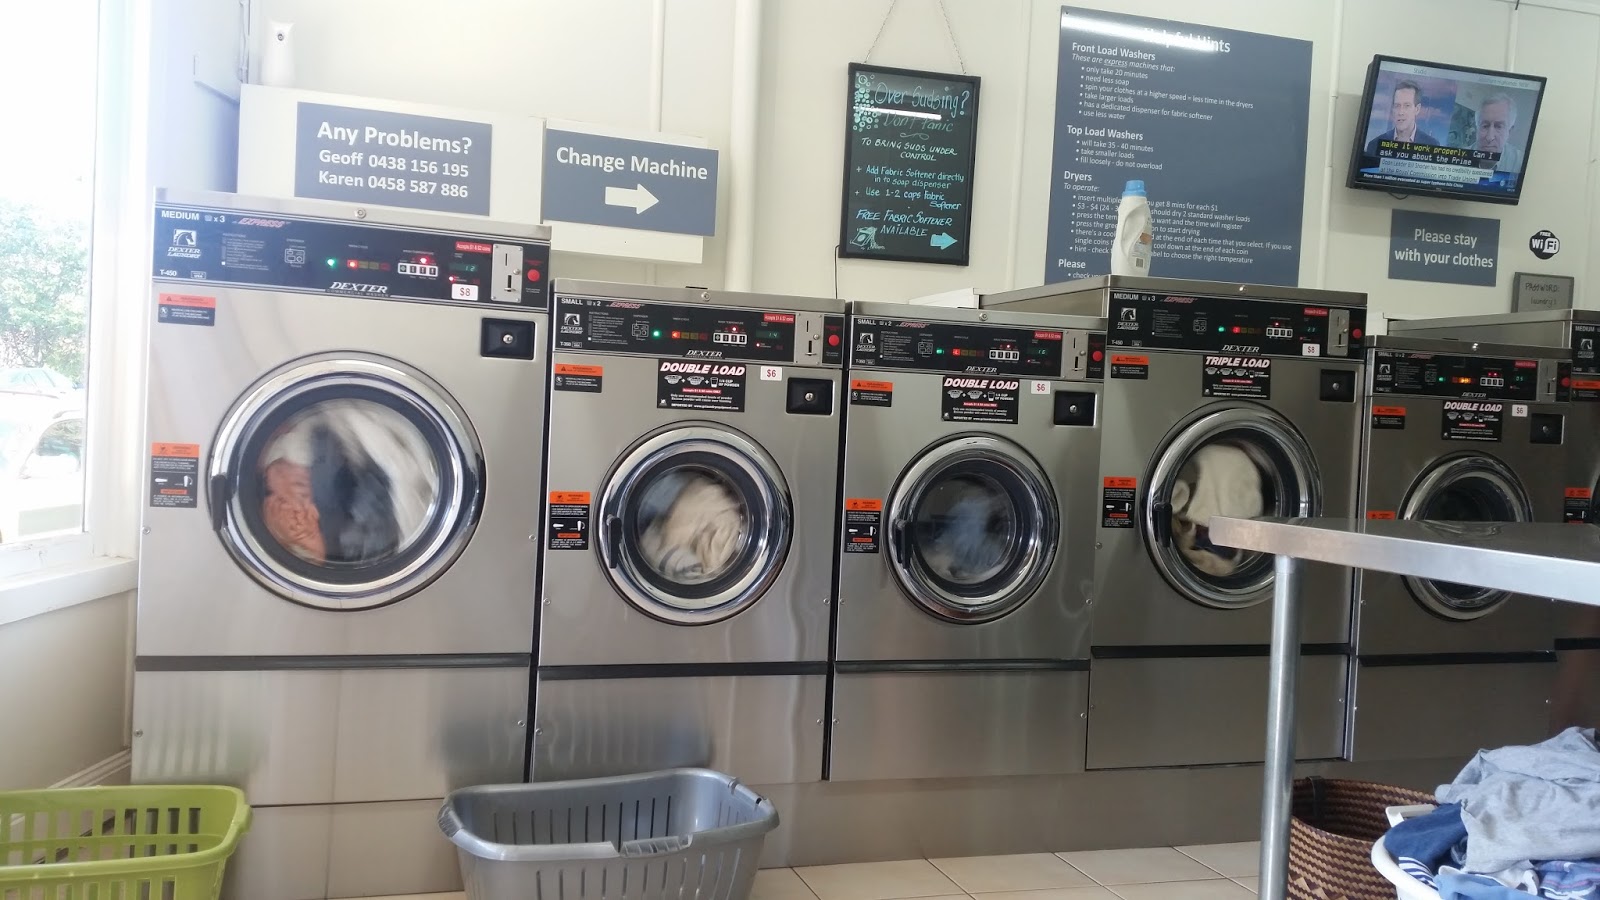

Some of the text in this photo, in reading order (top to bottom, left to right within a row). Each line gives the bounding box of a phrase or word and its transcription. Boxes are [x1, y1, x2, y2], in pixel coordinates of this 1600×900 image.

[1072, 42, 1156, 60] Front Load Washers
[1072, 53, 1090, 62] These
[1104, 58, 1128, 68] express
[1129, 61, 1158, 70] machines
[1160, 64, 1175, 72] that:
[1086, 66, 1099, 74] only
[1124, 70, 1148, 79] minutes
[875, 82, 970, 118] Over Sudsing?
[1099, 93, 1116, 102] larger
[1118, 95, 1133, 103] loads
[1114, 87, 1135, 95] clothes
[1150, 90, 1168, 99] higher
[1193, 95, 1203, 103] less
[1205, 96, 1217, 104] time
[1096, 110, 1106, 118] less
[1101, 103, 1130, 111] dedicated
[1132, 106, 1160, 115] dispenser
[1189, 112, 1212, 120] softener
[922, 118, 954, 132] Panic
[317, 121, 472, 155] Any Problems?
[1067, 125, 1143, 140] Top Load Washers
[861, 137, 958, 155] TO BRING SUDS UNDER
[1130, 144, 1154, 152] minutes
[1381, 141, 1398, 149] make
[1414, 144, 1430, 152] work
[1433, 148, 1468, 156] properly.
[900, 151, 936, 161] CONTROL
[1095, 150, 1117, 158] smaller
[319, 150, 469, 177] Geoff 0438 156 195
[556, 147, 708, 180] Change Machine
[1090, 157, 1111, 166] loosely
[1136, 162, 1163, 170] overload
[1452, 157, 1472, 165] Prime
[866, 165, 964, 182] Add Fabric Softener directly
[1064, 171, 1092, 182] Dryers
[319, 170, 468, 198] Karen 0458 587 886
[892, 179, 909, 187] soap
[912, 179, 951, 189] dispenser
[1064, 182, 1100, 192] To operate:
[866, 187, 944, 200] Use 1-2 caps Fabric
[930, 201, 961, 210] Softener
[161, 210, 199, 220] MEDIUM
[856, 209, 952, 226] FREE FABRIC SOFTENER
[880, 224, 928, 236] AVAILABLE
[1414, 228, 1477, 249] Please stay
[1058, 259, 1086, 268] Please
[1394, 249, 1494, 268] with your clothes
[330, 282, 388, 293] DEXTER
[460, 287, 470, 296] $8
[1222, 344, 1260, 352] DEXTER
[1205, 356, 1270, 368] TRIPLE LOAD
[660, 362, 745, 376] DOUBLE LOAD
[767, 369, 776, 377] $6
[944, 378, 1018, 390] DOUBLE LOAD
[1444, 402, 1502, 412] DOUBLE LOAD
